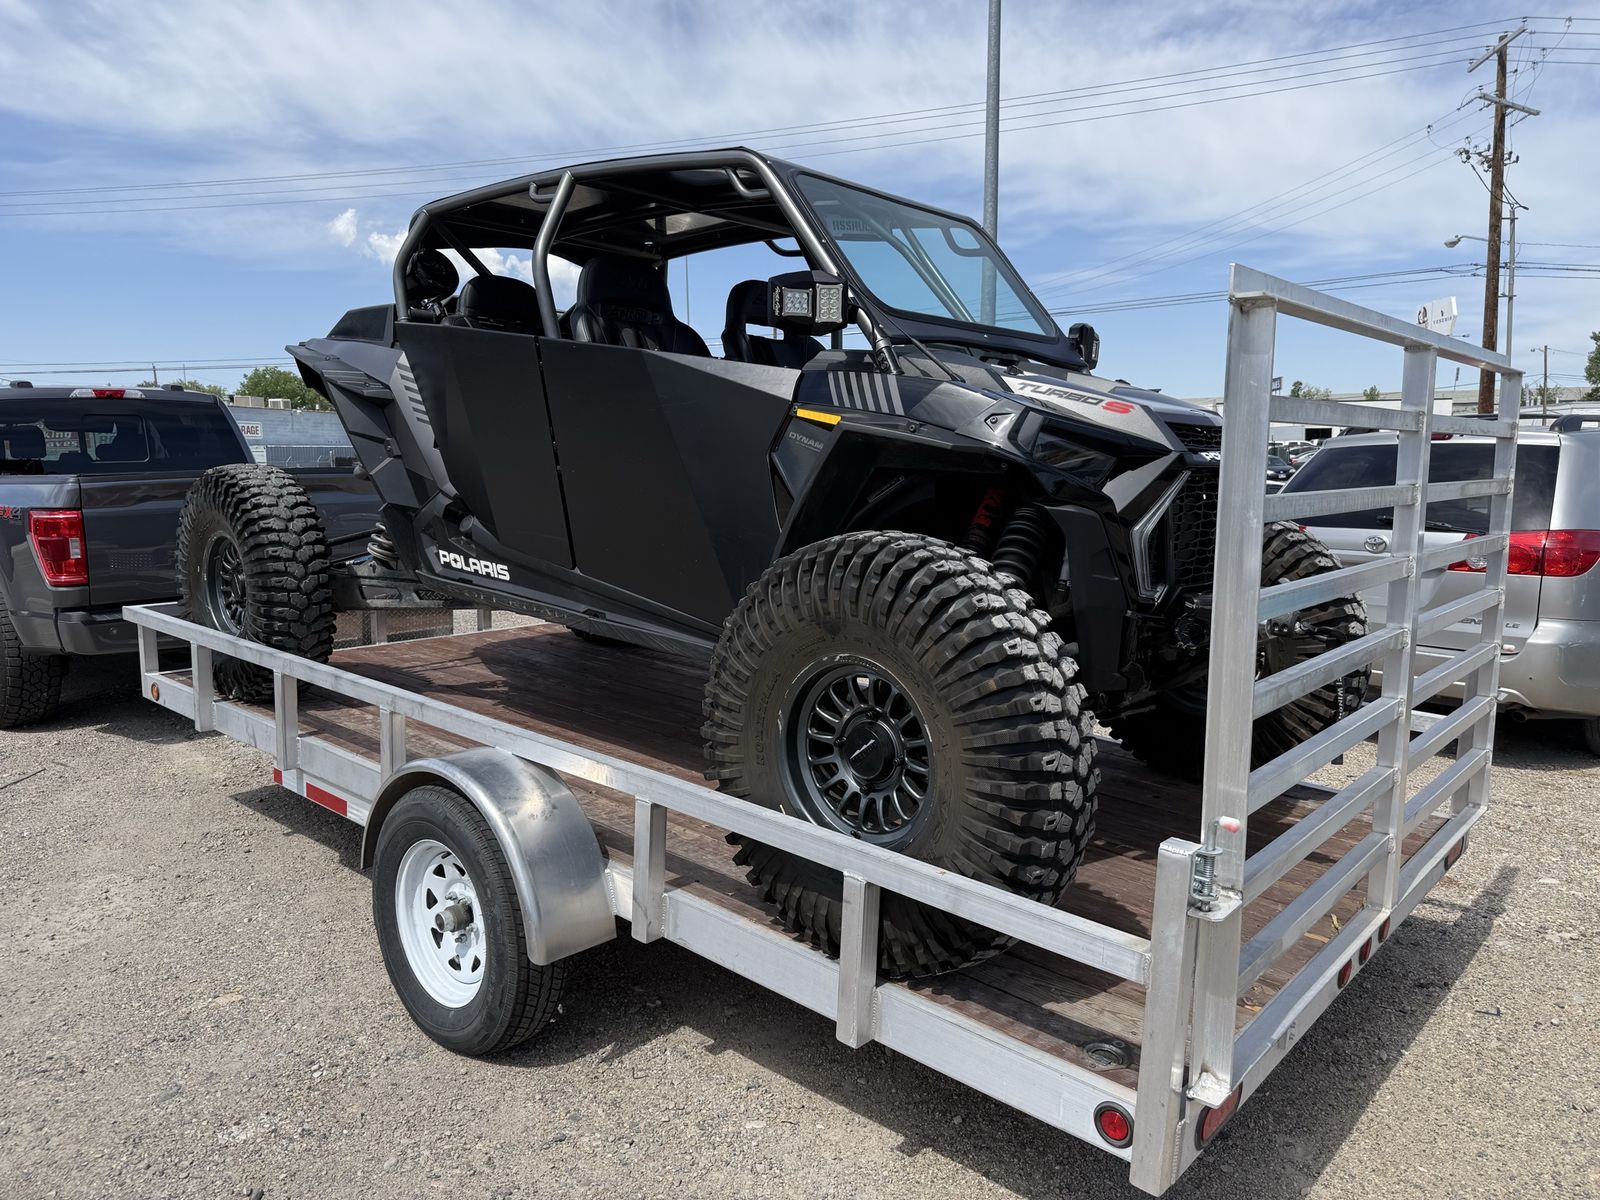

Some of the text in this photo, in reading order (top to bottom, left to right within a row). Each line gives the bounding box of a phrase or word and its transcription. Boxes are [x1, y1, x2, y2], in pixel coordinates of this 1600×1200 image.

[1017, 382, 1136, 414] TURBO S
[438, 549, 510, 581] POLARIS
